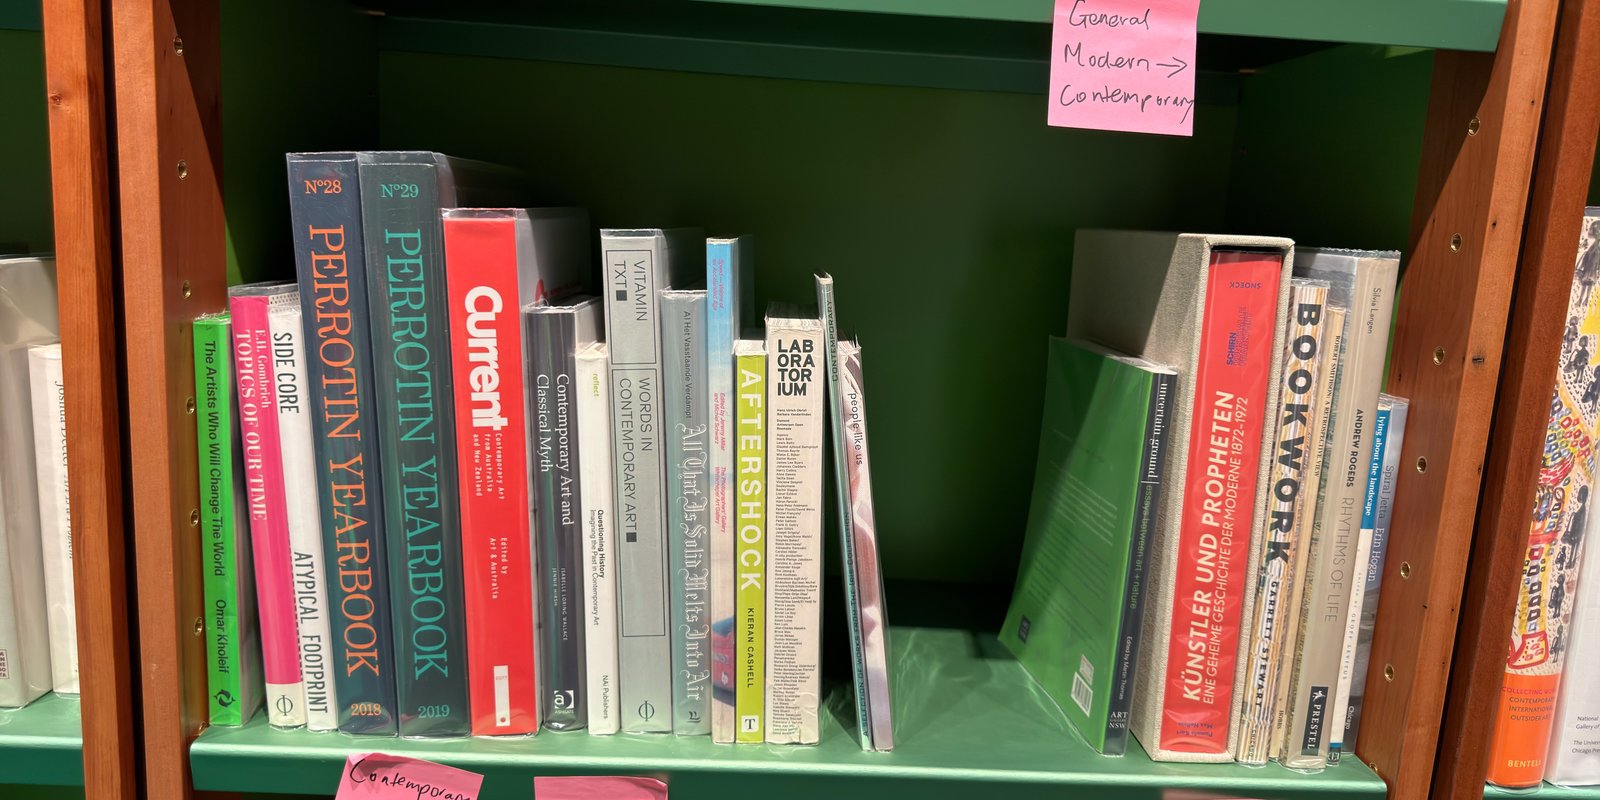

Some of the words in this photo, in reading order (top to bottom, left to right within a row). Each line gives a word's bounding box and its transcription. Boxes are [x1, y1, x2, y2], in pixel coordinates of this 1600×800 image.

[1069, 0, 1150, 30] General
[1064, 42, 1150, 71] Modern
[1060, 84, 1195, 124] Contemporary
[614, 261, 627, 289] TXT
[633, 260, 648, 321] VITAMIN
[1371, 287, 1382, 307] Silvia
[309, 224, 361, 440] PERROTIN
[684, 311, 691, 320] Al
[684, 322, 692, 336] Het
[1366, 308, 1379, 334] Langen
[204, 340, 216, 364] The
[255, 330, 266, 352] E.H.
[273, 332, 296, 368] SIDE
[385, 228, 435, 443] PERROTIN
[777, 339, 814, 353] LAB
[827, 300, 838, 382] CONTEMPORARY
[1226, 332, 1237, 365] SCHIRN
[1331, 335, 1341, 362] ROBERT
[236, 329, 256, 399] TOPICS
[464, 286, 508, 431] Current
[777, 354, 815, 367] ORA
[777, 368, 812, 382] TOR
[205, 367, 217, 409] Artists
[256, 354, 269, 409] Gombrich
[278, 370, 299, 414] CORE
[777, 383, 807, 396] IUM
[243, 403, 258, 429] OF
[536, 374, 552, 435] Classical
[639, 377, 653, 433] WORDS
[685, 383, 693, 419] Verdampt
[848, 393, 860, 429] people
[1154, 383, 1168, 435] uncertain
[207, 412, 220, 440] Who
[555, 374, 569, 472] Contemporary
[619, 378, 636, 499] CONTEMPORARY
[675, 423, 707, 451] All
[853, 431, 862, 450] like
[1231, 397, 1248, 455] 1872-1972
[1265, 303, 1321, 565] BOOKWORK
[1316, 406, 1331, 456] RETROSPECTIVE
[1351, 409, 1363, 448] ANDREW
[1375, 416, 1387, 437] lying
[209, 443, 221, 469] Will
[246, 432, 262, 471] OUR
[484, 433, 492, 450] from
[495, 433, 505, 485] Contemporary
[537, 437, 553, 472] Myth
[641, 437, 653, 451] IN
[856, 454, 862, 465] us
[1147, 438, 1161, 479] ground
[1202, 391, 1235, 528] PROPHETEN
[1373, 437, 1382, 462] about
[474, 467, 483, 497] Zealand
[485, 452, 494, 493] Australia
[676, 452, 707, 496] That
[741, 368, 762, 591] AFTERSHOCK
[1313, 458, 1321, 477] VIEW
[1346, 450, 1358, 488] ROGERS
[1371, 463, 1380, 476] the
[1382, 465, 1395, 495] Spiral
[209, 471, 221, 514] Change
[250, 473, 267, 521] TIME
[561, 476, 573, 498] Art
[1143, 485, 1153, 518] essays
[1224, 457, 1242, 521] MODERNE
[1364, 477, 1378, 517] landscape
[562, 499, 574, 526] and
[625, 503, 637, 530] ART
[1378, 495, 1389, 519] Jetta
[211, 516, 222, 539] The
[679, 522, 707, 567] Solid
[1137, 519, 1149, 558] between
[1220, 522, 1234, 546] DER
[1333, 497, 1354, 566] RHYTHMS
[1373, 527, 1385, 548] Erin
[213, 541, 224, 577] World
[329, 453, 379, 677] YEARBOOK
[402, 455, 448, 680] YEARBOOK
[500, 537, 508, 563] Edited
[1134, 560, 1143, 575] art
[1194, 539, 1218, 585] UND
[1368, 550, 1382, 582] Hogan
[491, 562, 499, 599] Australia
[501, 565, 509, 575] by
[1329, 569, 1343, 591] OF
[294, 552, 318, 625] ATYPICAL
[591, 573, 599, 617] Contemporary
[677, 568, 709, 623] Melts
[1130, 582, 1140, 609] nature
[1211, 553, 1231, 625] GESCHICHTE
[216, 599, 227, 632] Omar
[1264, 581, 1279, 640] GARRETT
[1324, 593, 1340, 623] LIFE
[217, 632, 229, 675] Kholeif
[679, 624, 709, 668] Into
[1182, 588, 1212, 701] KÜNSTLER
[1206, 627, 1223, 677] GEHEIME
[302, 634, 328, 714] FOOTPRINT
[680, 669, 710, 701] Air
[1118, 678, 1127, 700] Thomas
[1202, 677, 1217, 705] EINE
[1256, 645, 1269, 708] STEWART
[351, 703, 382, 717] 2018
[418, 705, 450, 719] 2019
[745, 719, 755, 730] T
[1108, 722, 1126, 730] NSW
[1307, 704, 1322, 751] PRESTEL
[1344, 705, 1355, 730] Chicago
[349, 759, 471, 800] Contemporar
